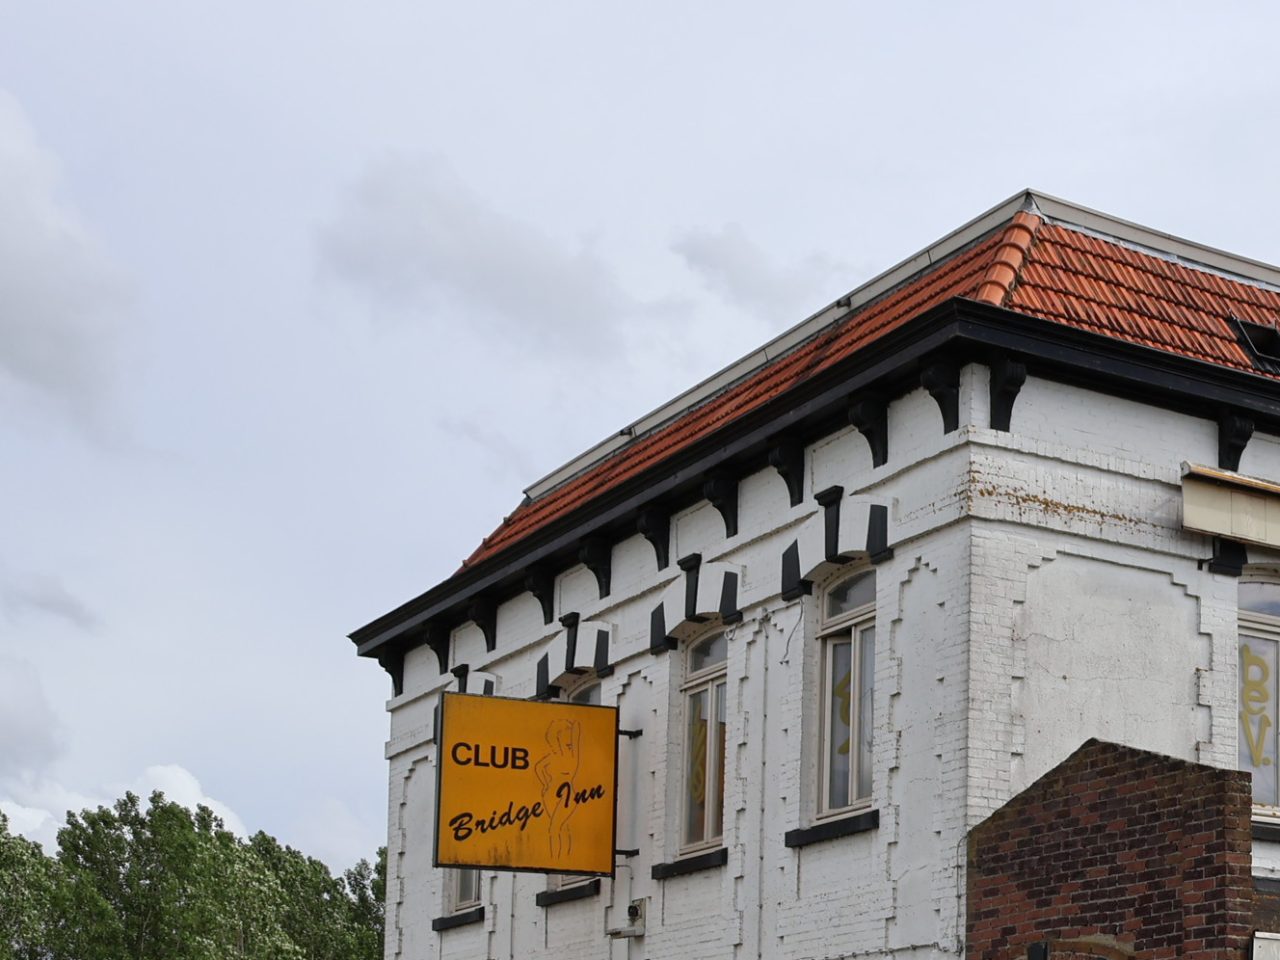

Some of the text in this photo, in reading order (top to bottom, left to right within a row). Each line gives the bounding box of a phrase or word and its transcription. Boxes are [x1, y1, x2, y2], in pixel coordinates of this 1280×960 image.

[451, 742, 530, 770] CLUB
[449, 782, 605, 842] Bridge Inn
